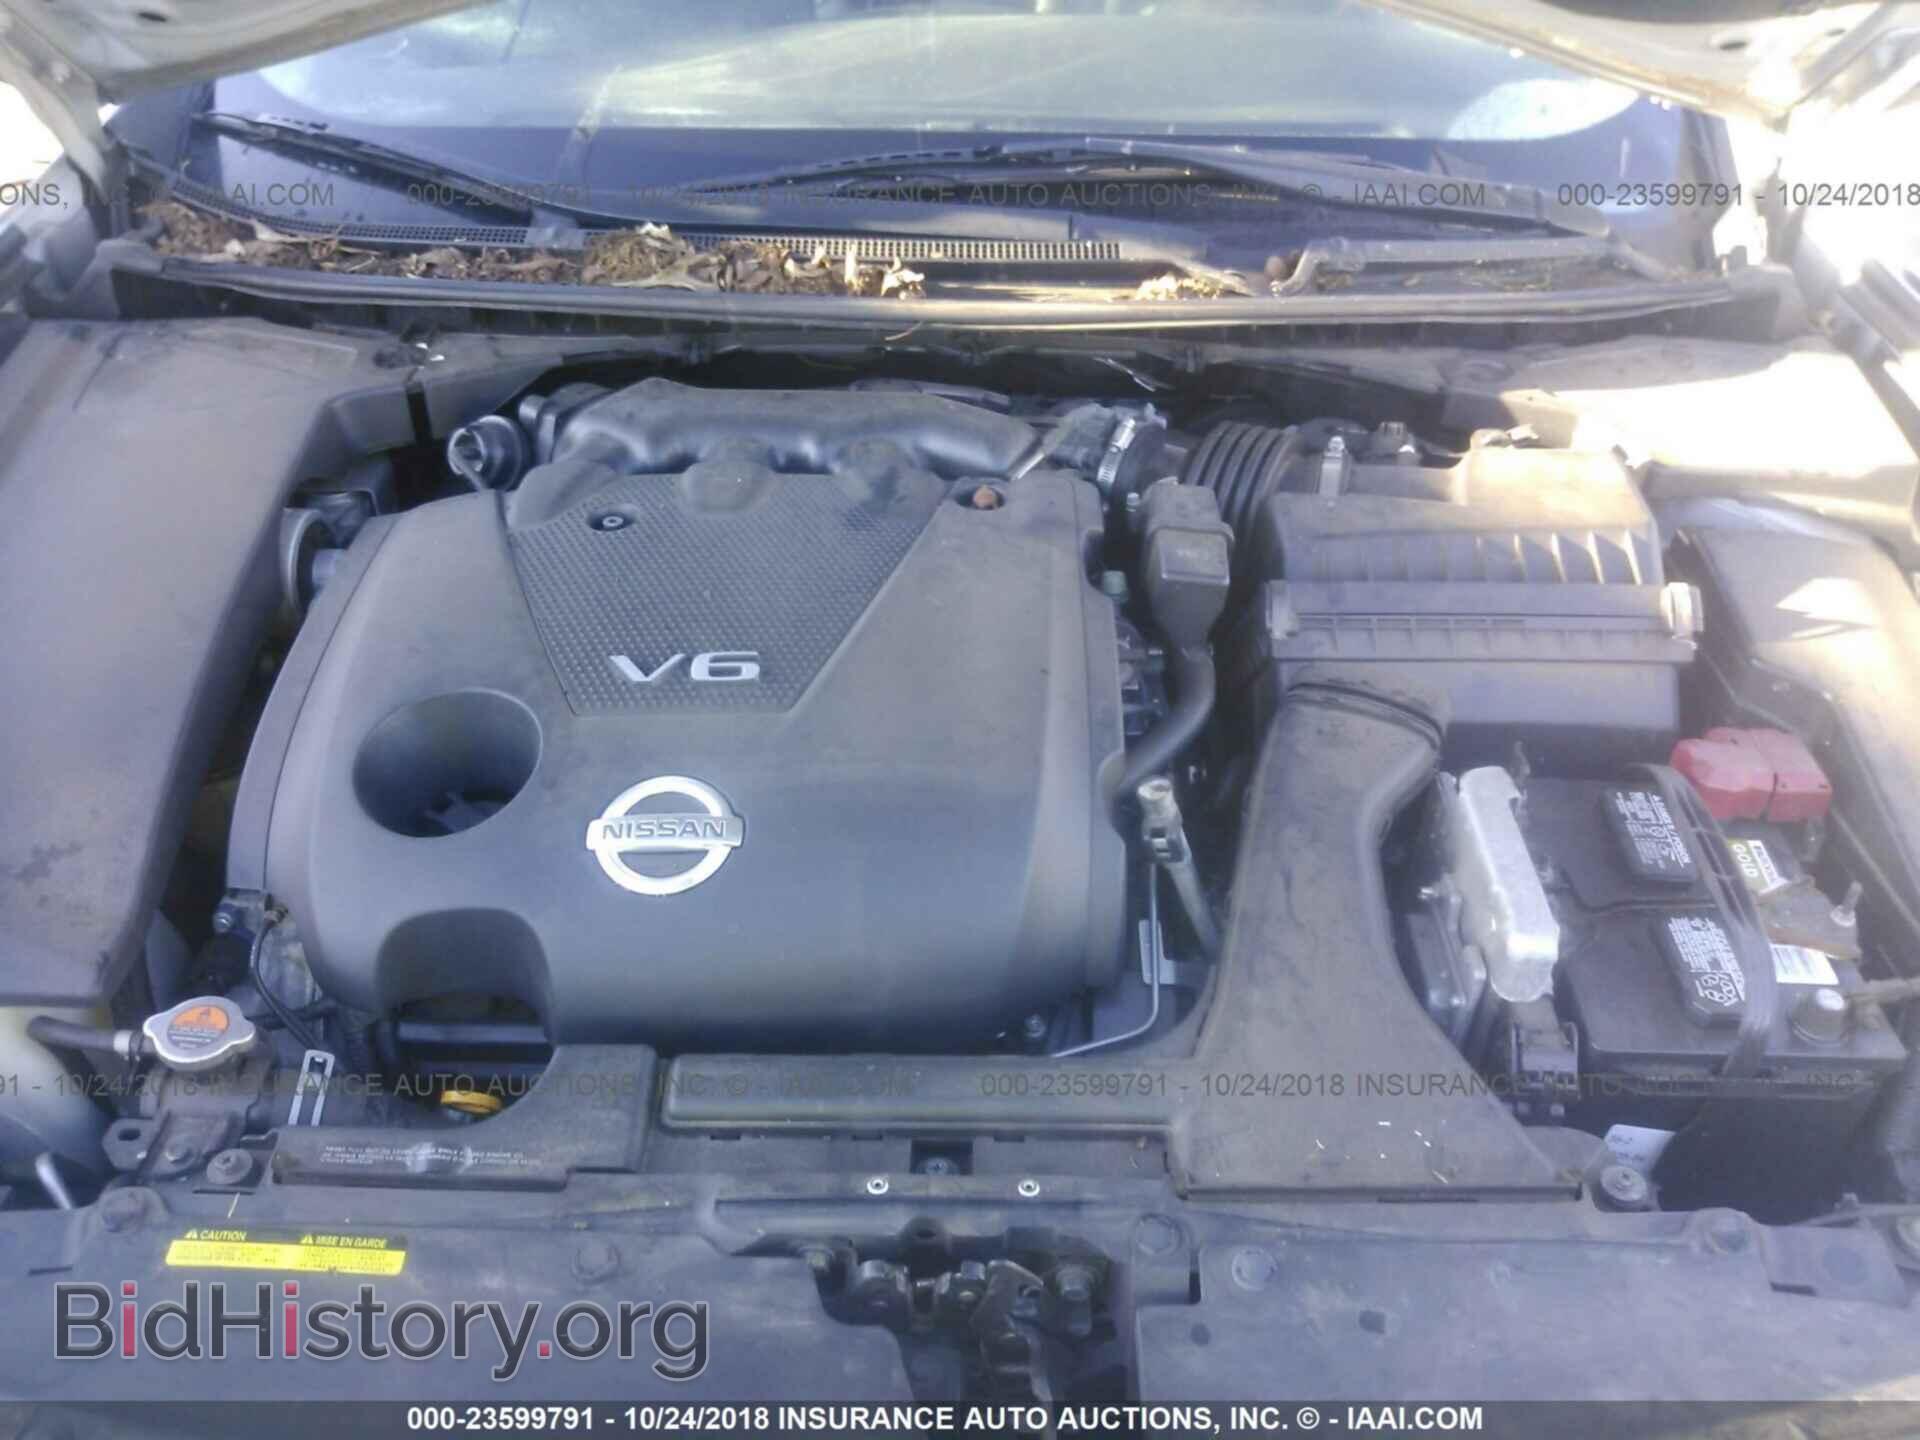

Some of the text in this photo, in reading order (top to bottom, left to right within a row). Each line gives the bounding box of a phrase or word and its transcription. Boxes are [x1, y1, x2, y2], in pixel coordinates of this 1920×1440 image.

[609, 651, 760, 682] V6
[602, 819, 725, 840] NISSAN
[199, 1230, 247, 1242] CAUTION
[339, 1235, 354, 1248] EN
